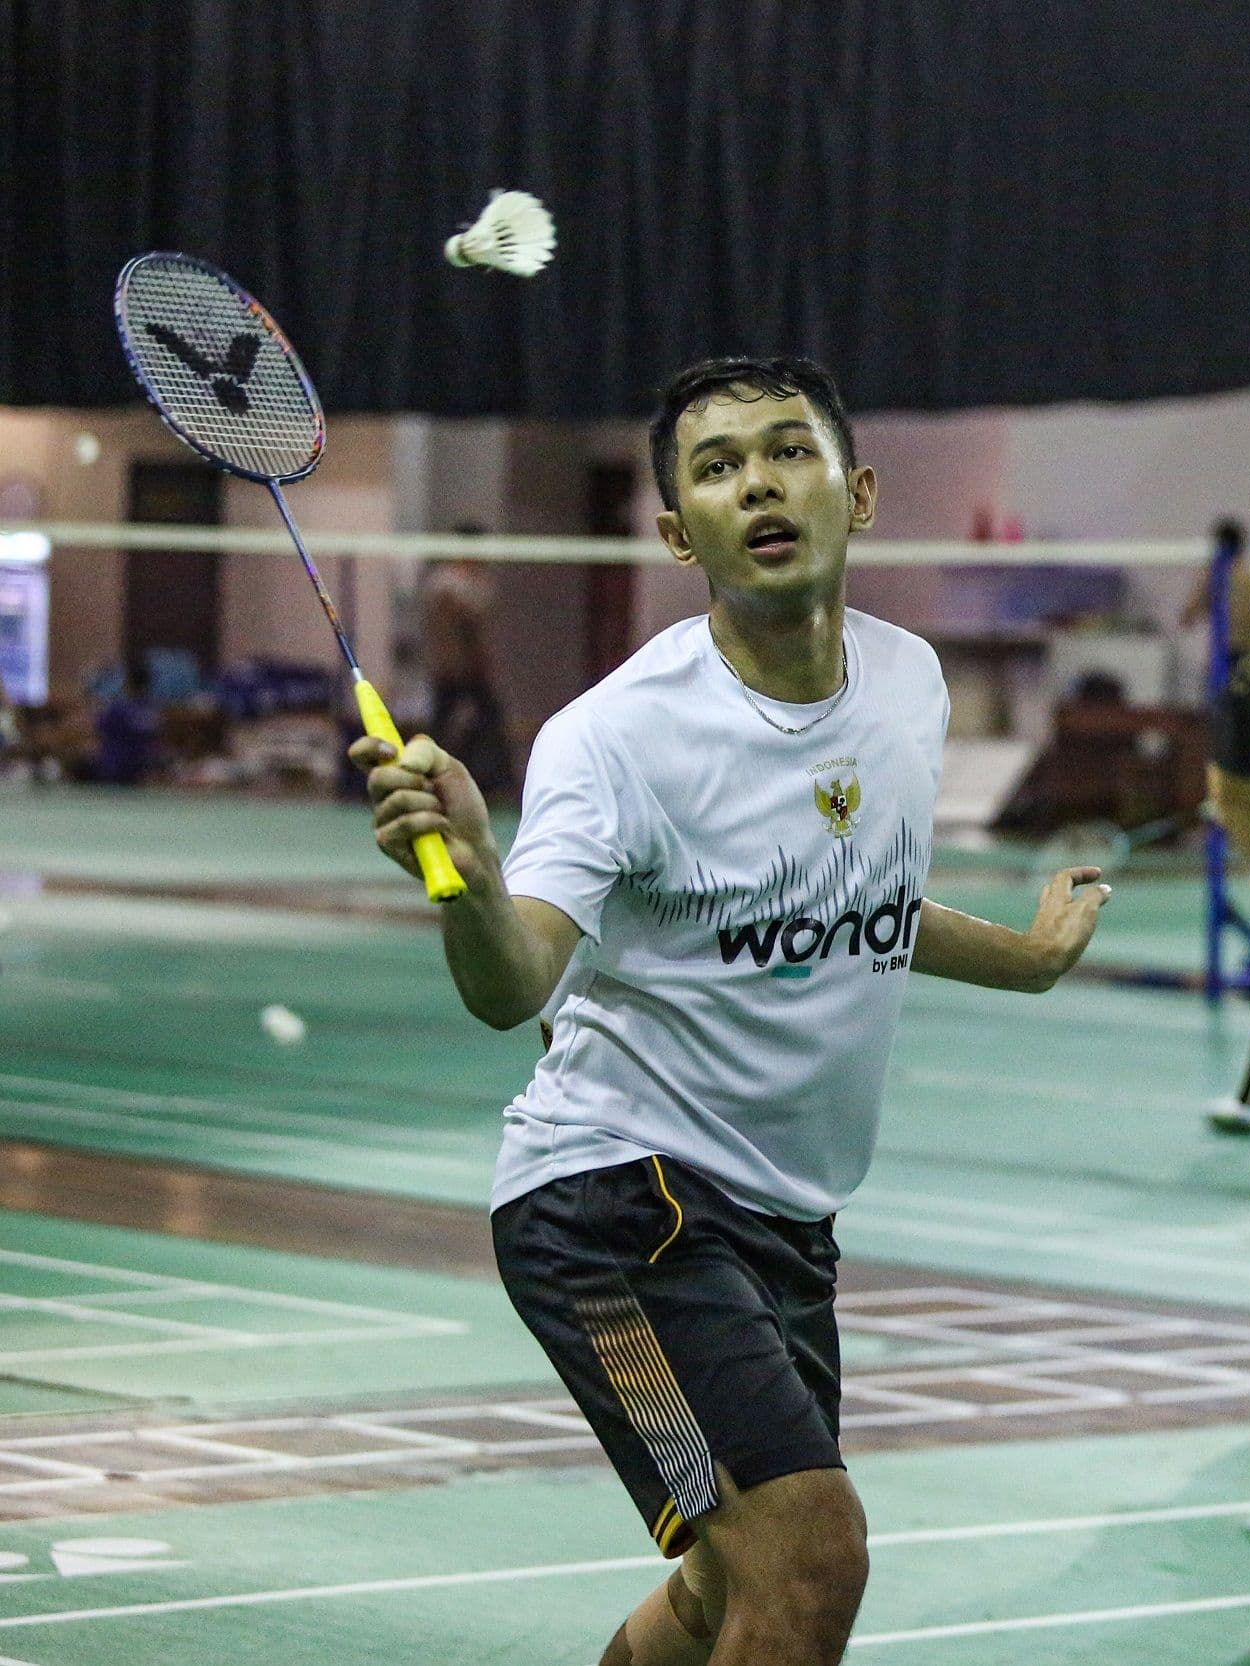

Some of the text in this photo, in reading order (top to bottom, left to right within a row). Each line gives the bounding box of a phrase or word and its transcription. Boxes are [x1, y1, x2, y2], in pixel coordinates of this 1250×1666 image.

[806, 757, 857, 776] INDONESIA
[718, 885, 922, 967] wondr
[872, 953, 908, 975] by BNI
